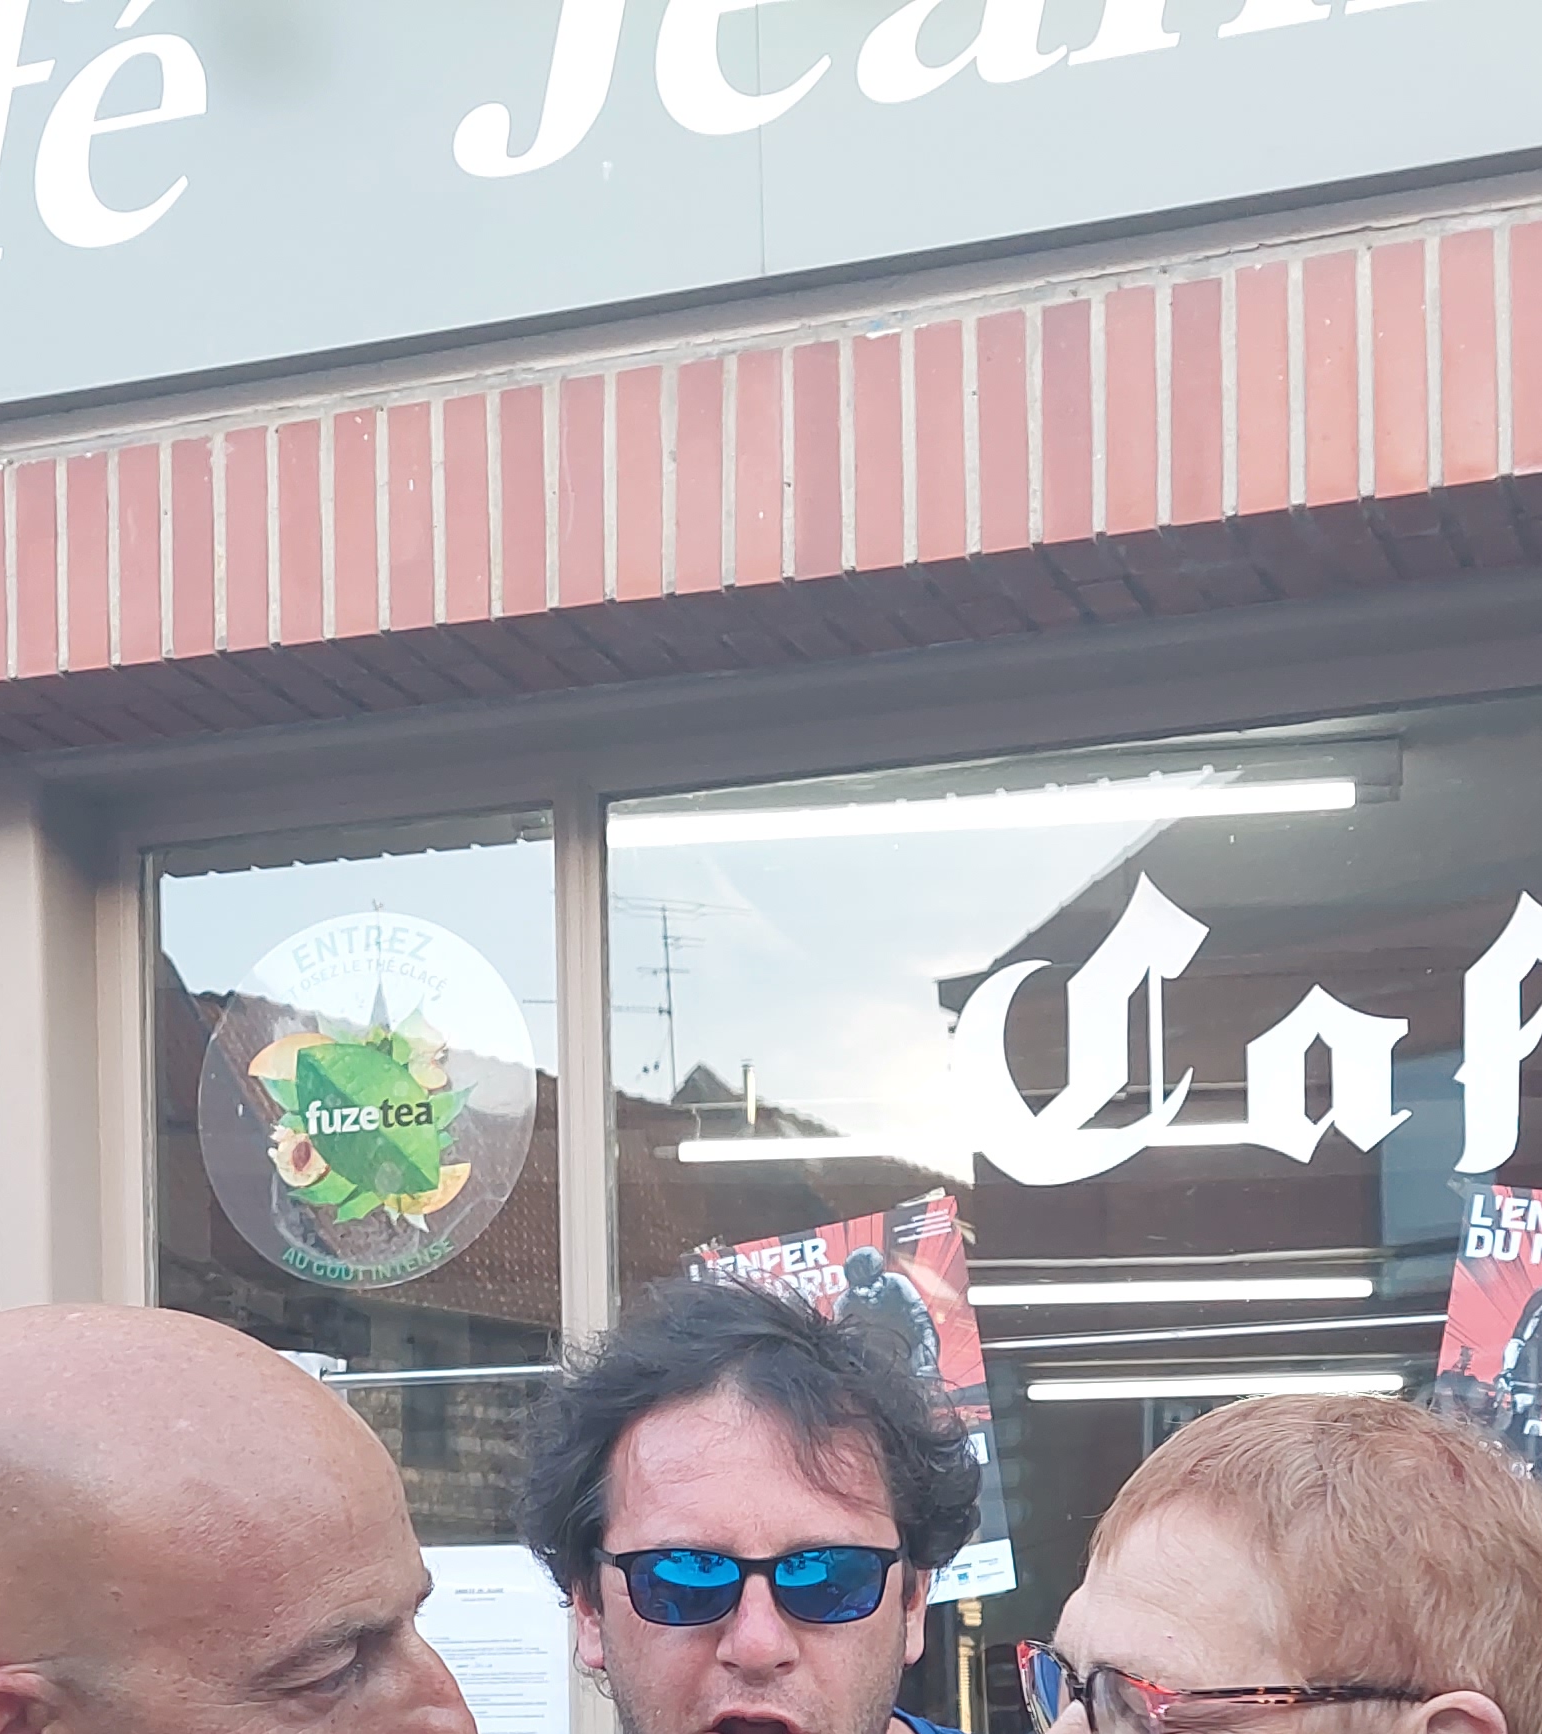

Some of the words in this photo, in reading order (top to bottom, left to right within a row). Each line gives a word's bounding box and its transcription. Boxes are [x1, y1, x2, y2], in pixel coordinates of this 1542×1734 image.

[291, 924, 434, 974] ENTREZ
[342, 959, 361, 974] LE
[399, 962, 448, 992] GLACÉ
[305, 1098, 434, 1135] fuzetea
[282, 1247, 309, 1270] AU
[372, 1238, 455, 1281] INTENSE
[1465, 1226, 1523, 1262] DU
